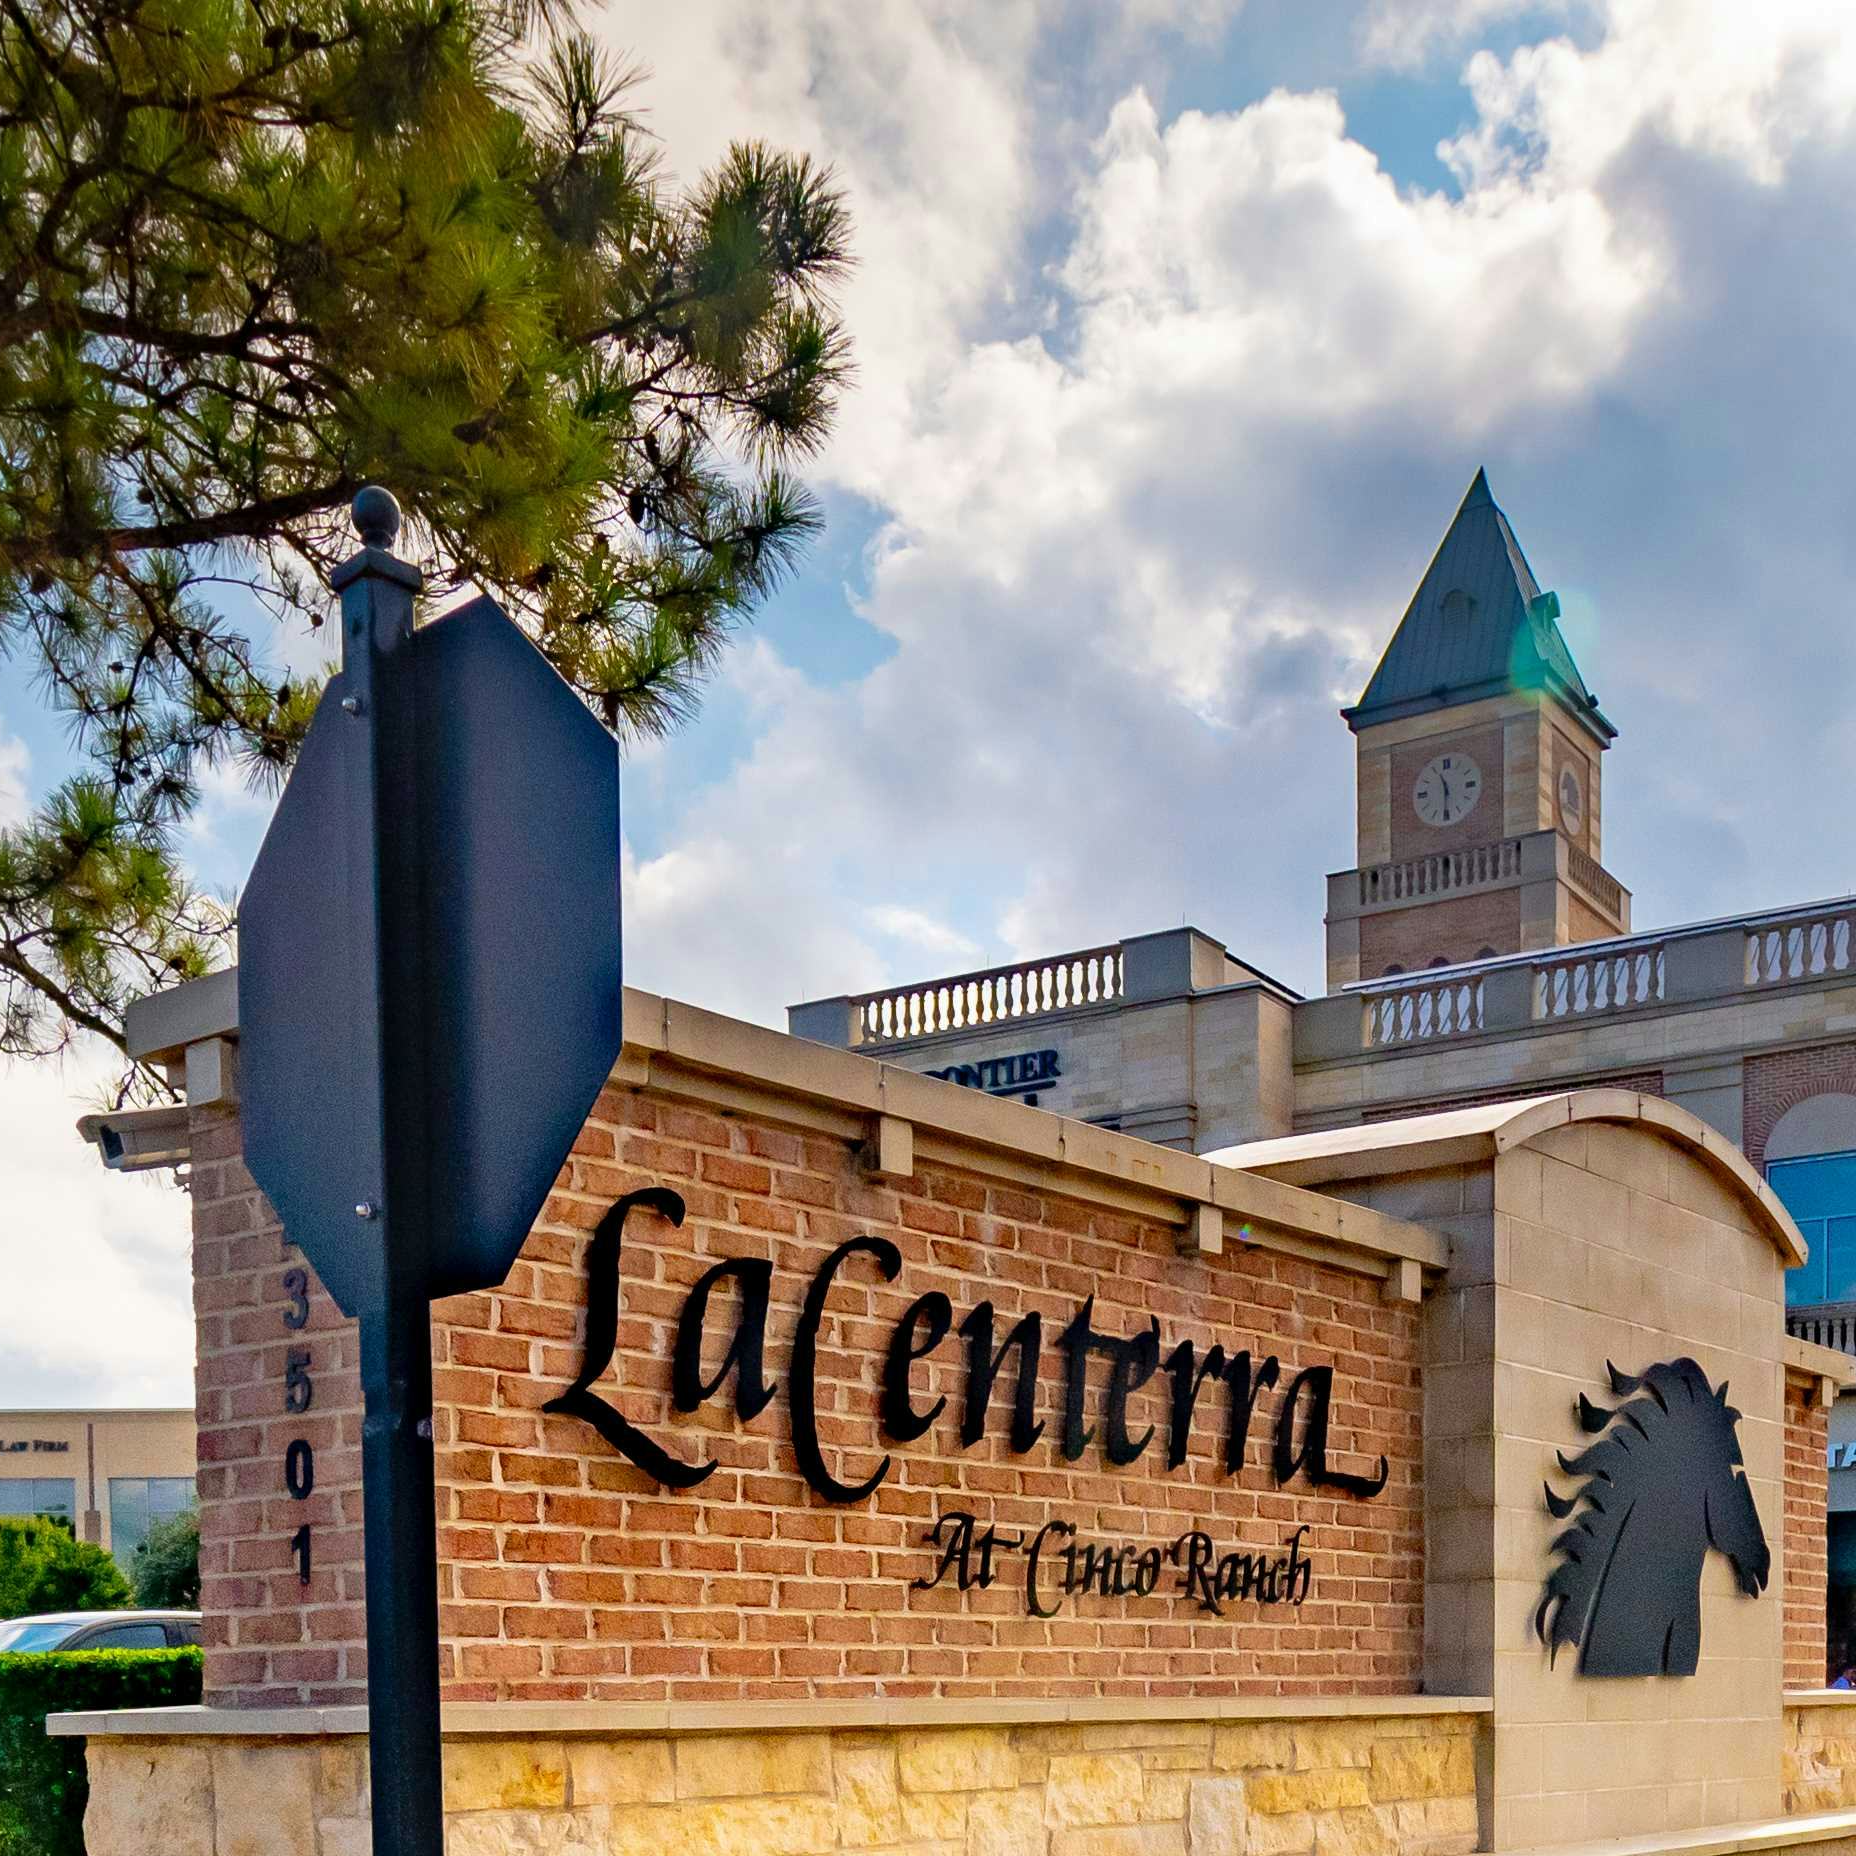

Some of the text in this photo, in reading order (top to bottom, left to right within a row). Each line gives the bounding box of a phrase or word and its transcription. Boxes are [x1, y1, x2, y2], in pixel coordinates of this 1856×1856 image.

[919, 1049, 1062, 1089] ONTIER
[911, 1511, 1313, 1618] At Cinco Ranch
